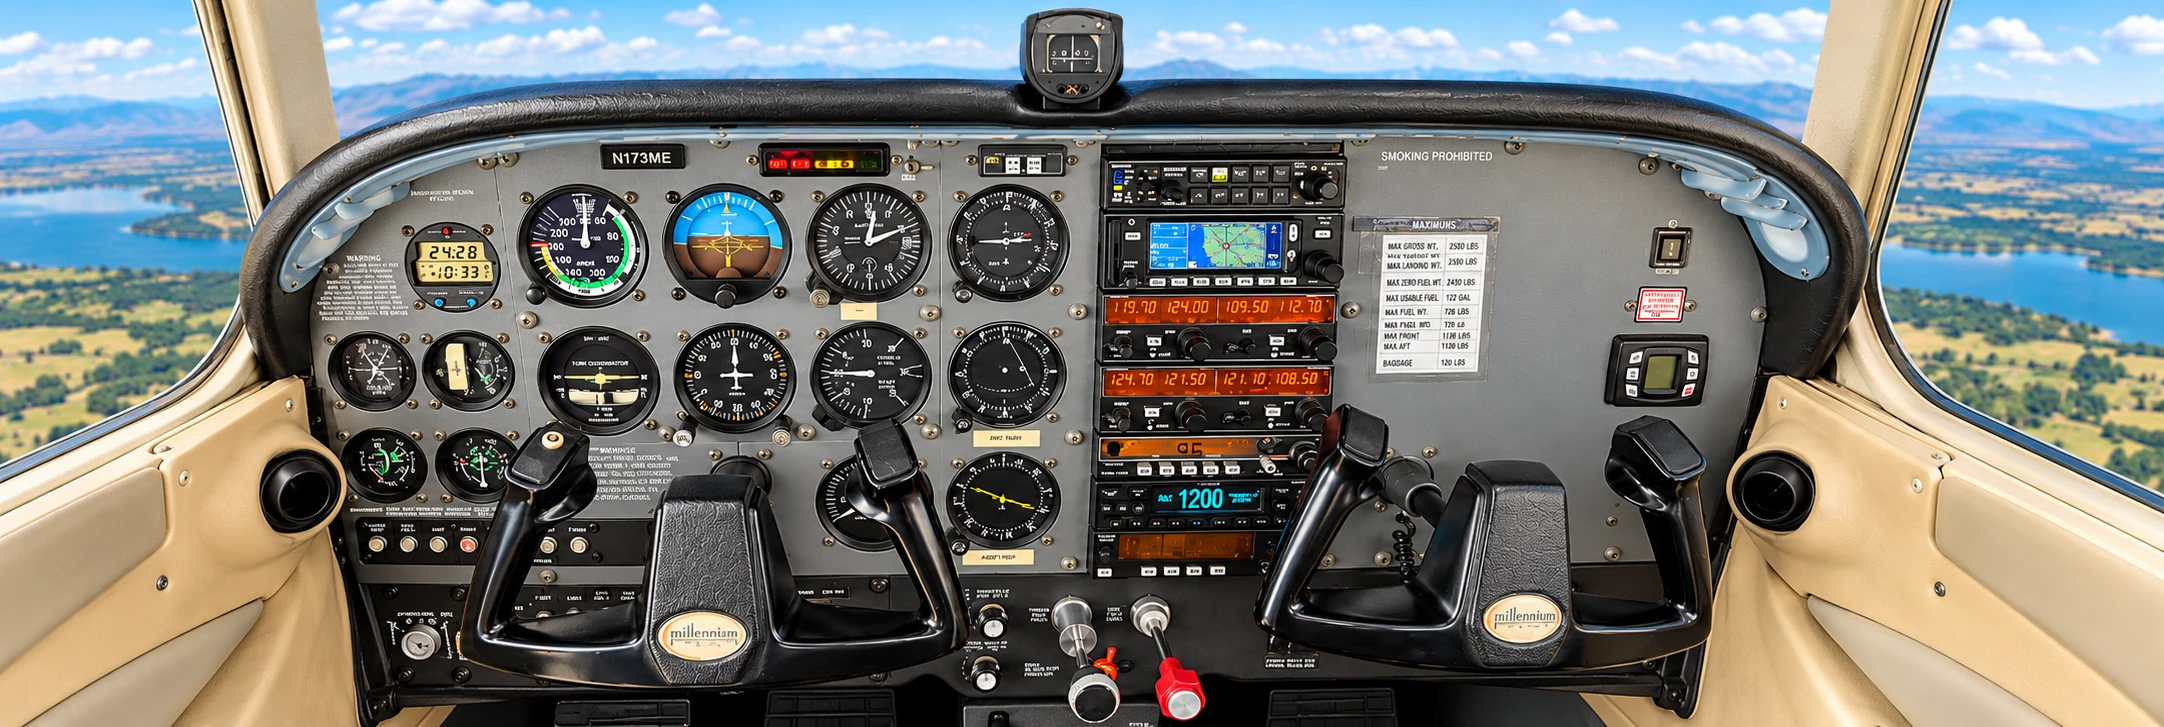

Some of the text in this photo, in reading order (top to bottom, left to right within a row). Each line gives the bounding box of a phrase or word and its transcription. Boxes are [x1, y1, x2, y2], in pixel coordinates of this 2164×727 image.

[612, 152, 672, 164] N173ME
[1381, 151, 1493, 161] SMOKING PROHIBITED
[429, 246, 477, 259] 24:28
[1115, 300, 1322, 314] 119.70 124.00 109.50 112.70
[1111, 372, 1154, 386] 124.70
[1165, 372, 1206, 386] 121.50
[1276, 372, 1318, 385] 108.50
[1179, 488, 1224, 509] 1200
[1495, 607, 1556, 622] millennium
